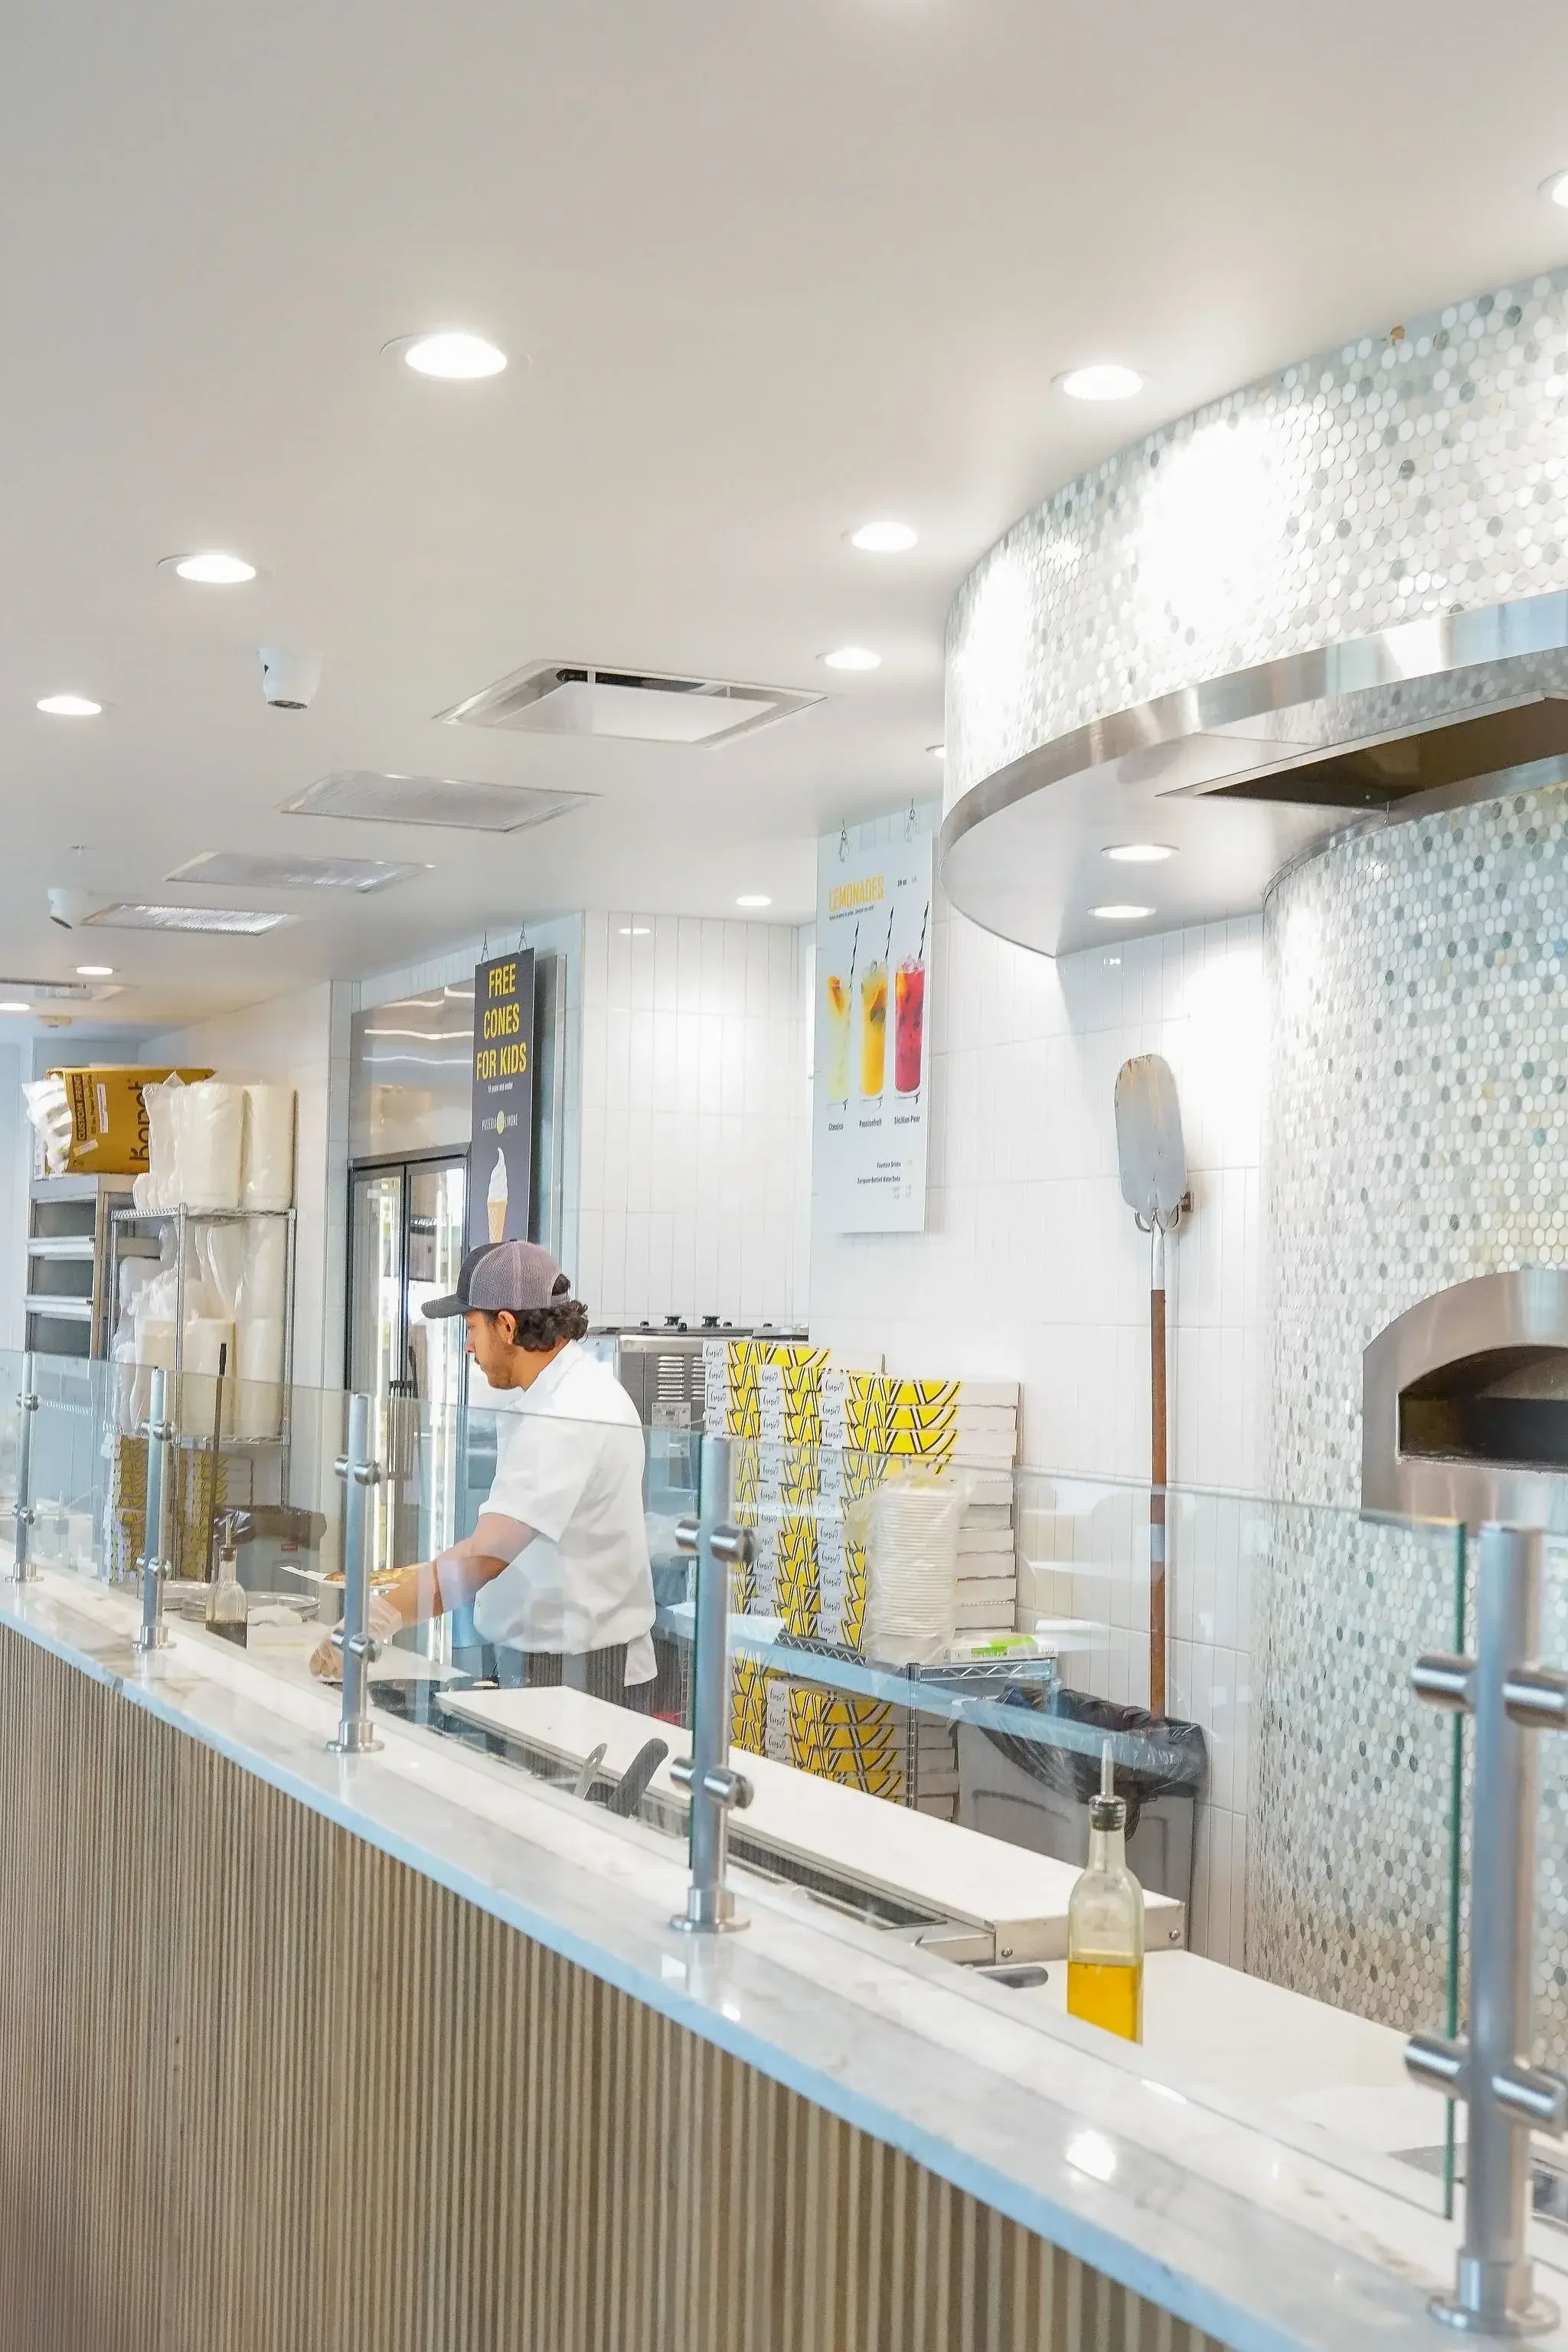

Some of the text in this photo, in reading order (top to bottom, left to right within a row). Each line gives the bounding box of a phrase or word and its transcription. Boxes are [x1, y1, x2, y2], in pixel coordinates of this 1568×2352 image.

[829, 876, 884, 912] LEMONADES
[488, 963, 516, 998] FREE
[483, 1002, 521, 1040] CONES
[476, 1042, 527, 1081] FOR KIDS
[859, 1119, 882, 1128] Passionfruit
[894, 1115, 920, 1125] Sicilian Pear
